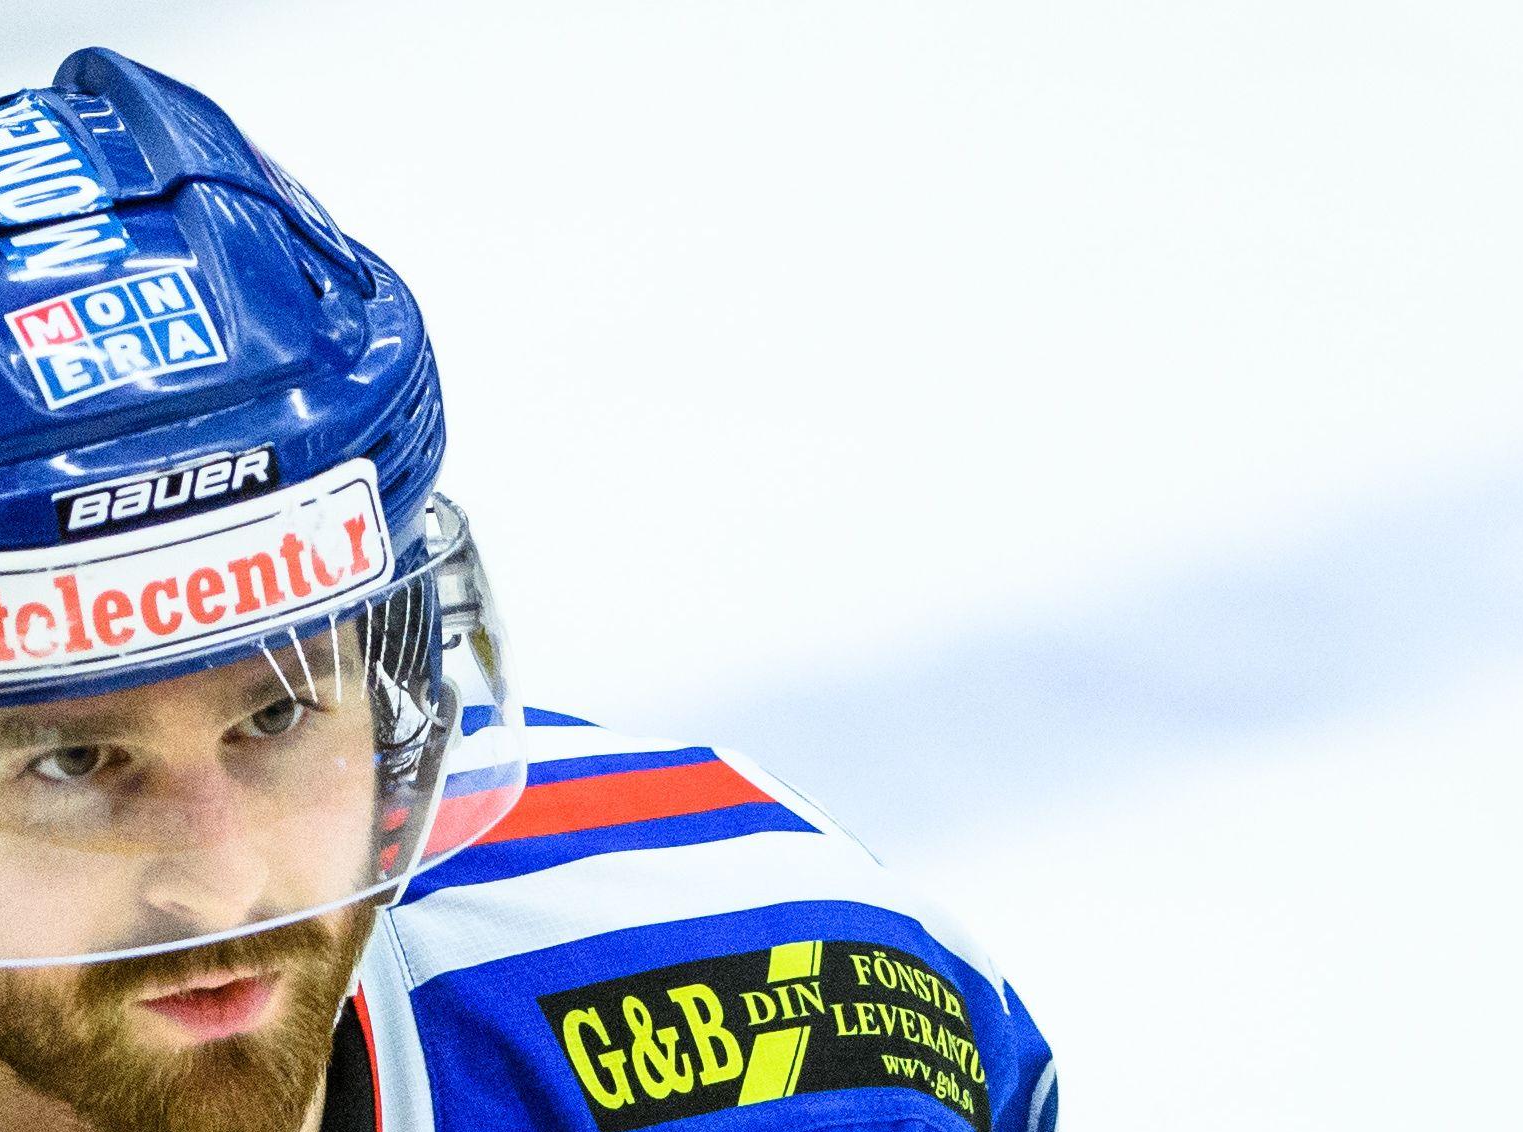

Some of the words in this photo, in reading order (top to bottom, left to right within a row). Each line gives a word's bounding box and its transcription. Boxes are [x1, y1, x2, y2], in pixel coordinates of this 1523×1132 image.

[67, 449, 271, 531] BAUER
[849, 950, 965, 1024] FÖNSTE
[563, 983, 745, 1110] G&B
[739, 982, 826, 1028] DIN
